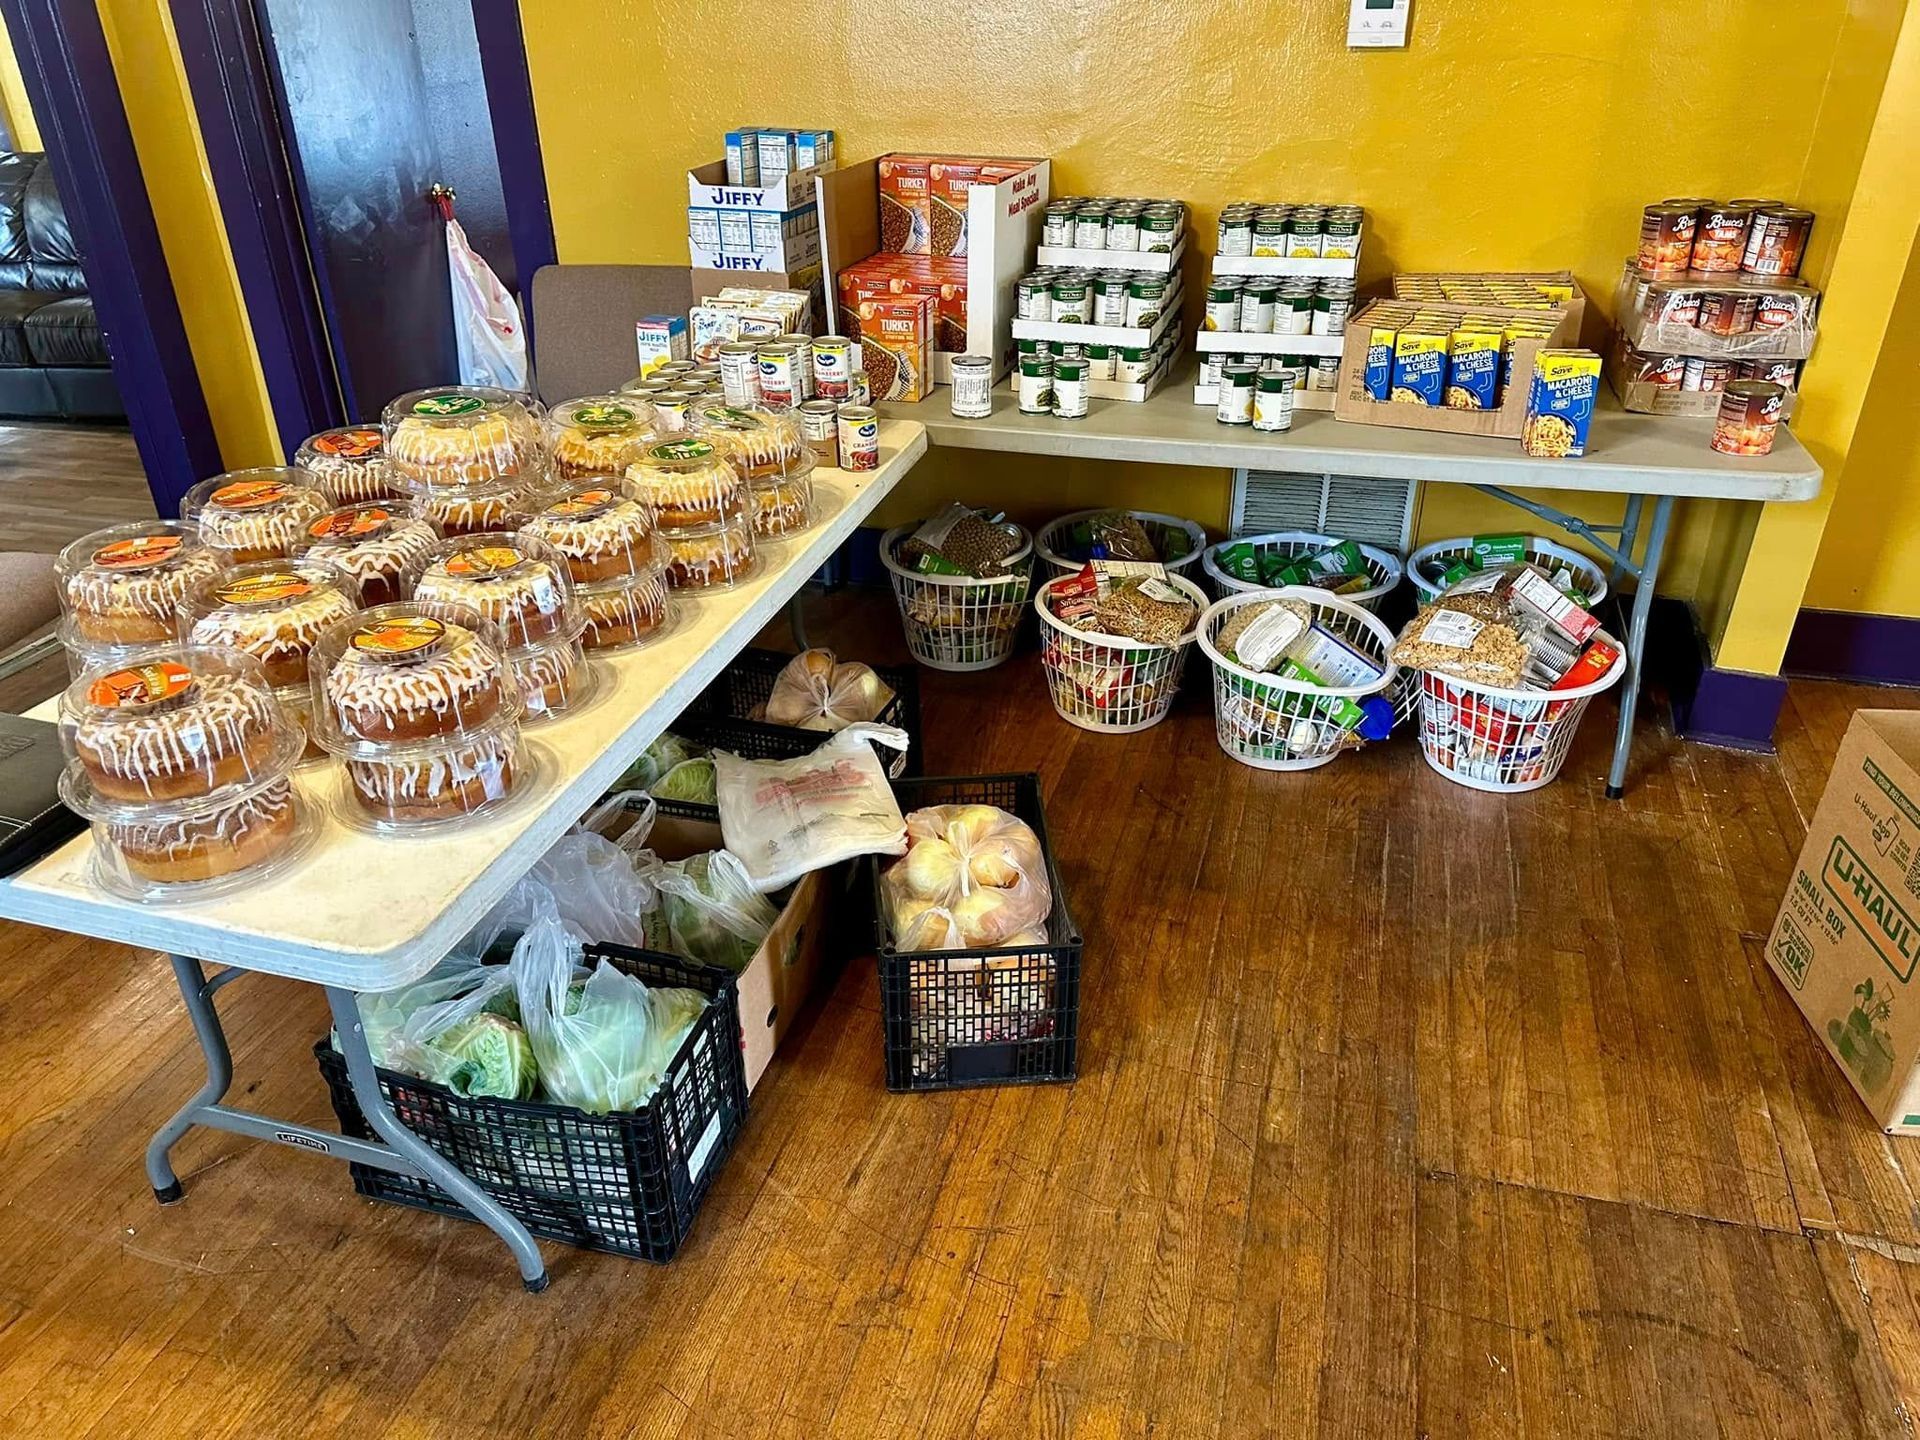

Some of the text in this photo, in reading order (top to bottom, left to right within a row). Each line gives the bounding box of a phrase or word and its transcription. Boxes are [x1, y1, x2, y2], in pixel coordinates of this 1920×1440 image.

[897, 177, 927, 189] TURKEY
[1705, 214, 1744, 229] Bruce's
[1758, 296, 1797, 311] Bruce's
[880, 318, 914, 332] TURKEY
[638, 331, 668, 343] JIFFY
[1400, 342, 1421, 351] Save
[1453, 341, 1475, 350] Save
[1398, 352, 1439, 365] MACARONI
[1452, 350, 1493, 364] MACARONI
[1412, 360, 1440, 371] CHEESE
[1466, 359, 1493, 370] CHEESE
[1550, 366, 1573, 376] Save
[1547, 376, 1593, 391] MACARONI
[1555, 385, 1593, 398] & CHEESE
[1854, 792, 1891, 839] U-Haul App
[1797, 869, 1846, 940] SMALL BOX
[1833, 847, 1911, 960] U-HAUL
[1785, 944, 1805, 978] OK
[280, 1134, 323, 1150] LIFETIME
